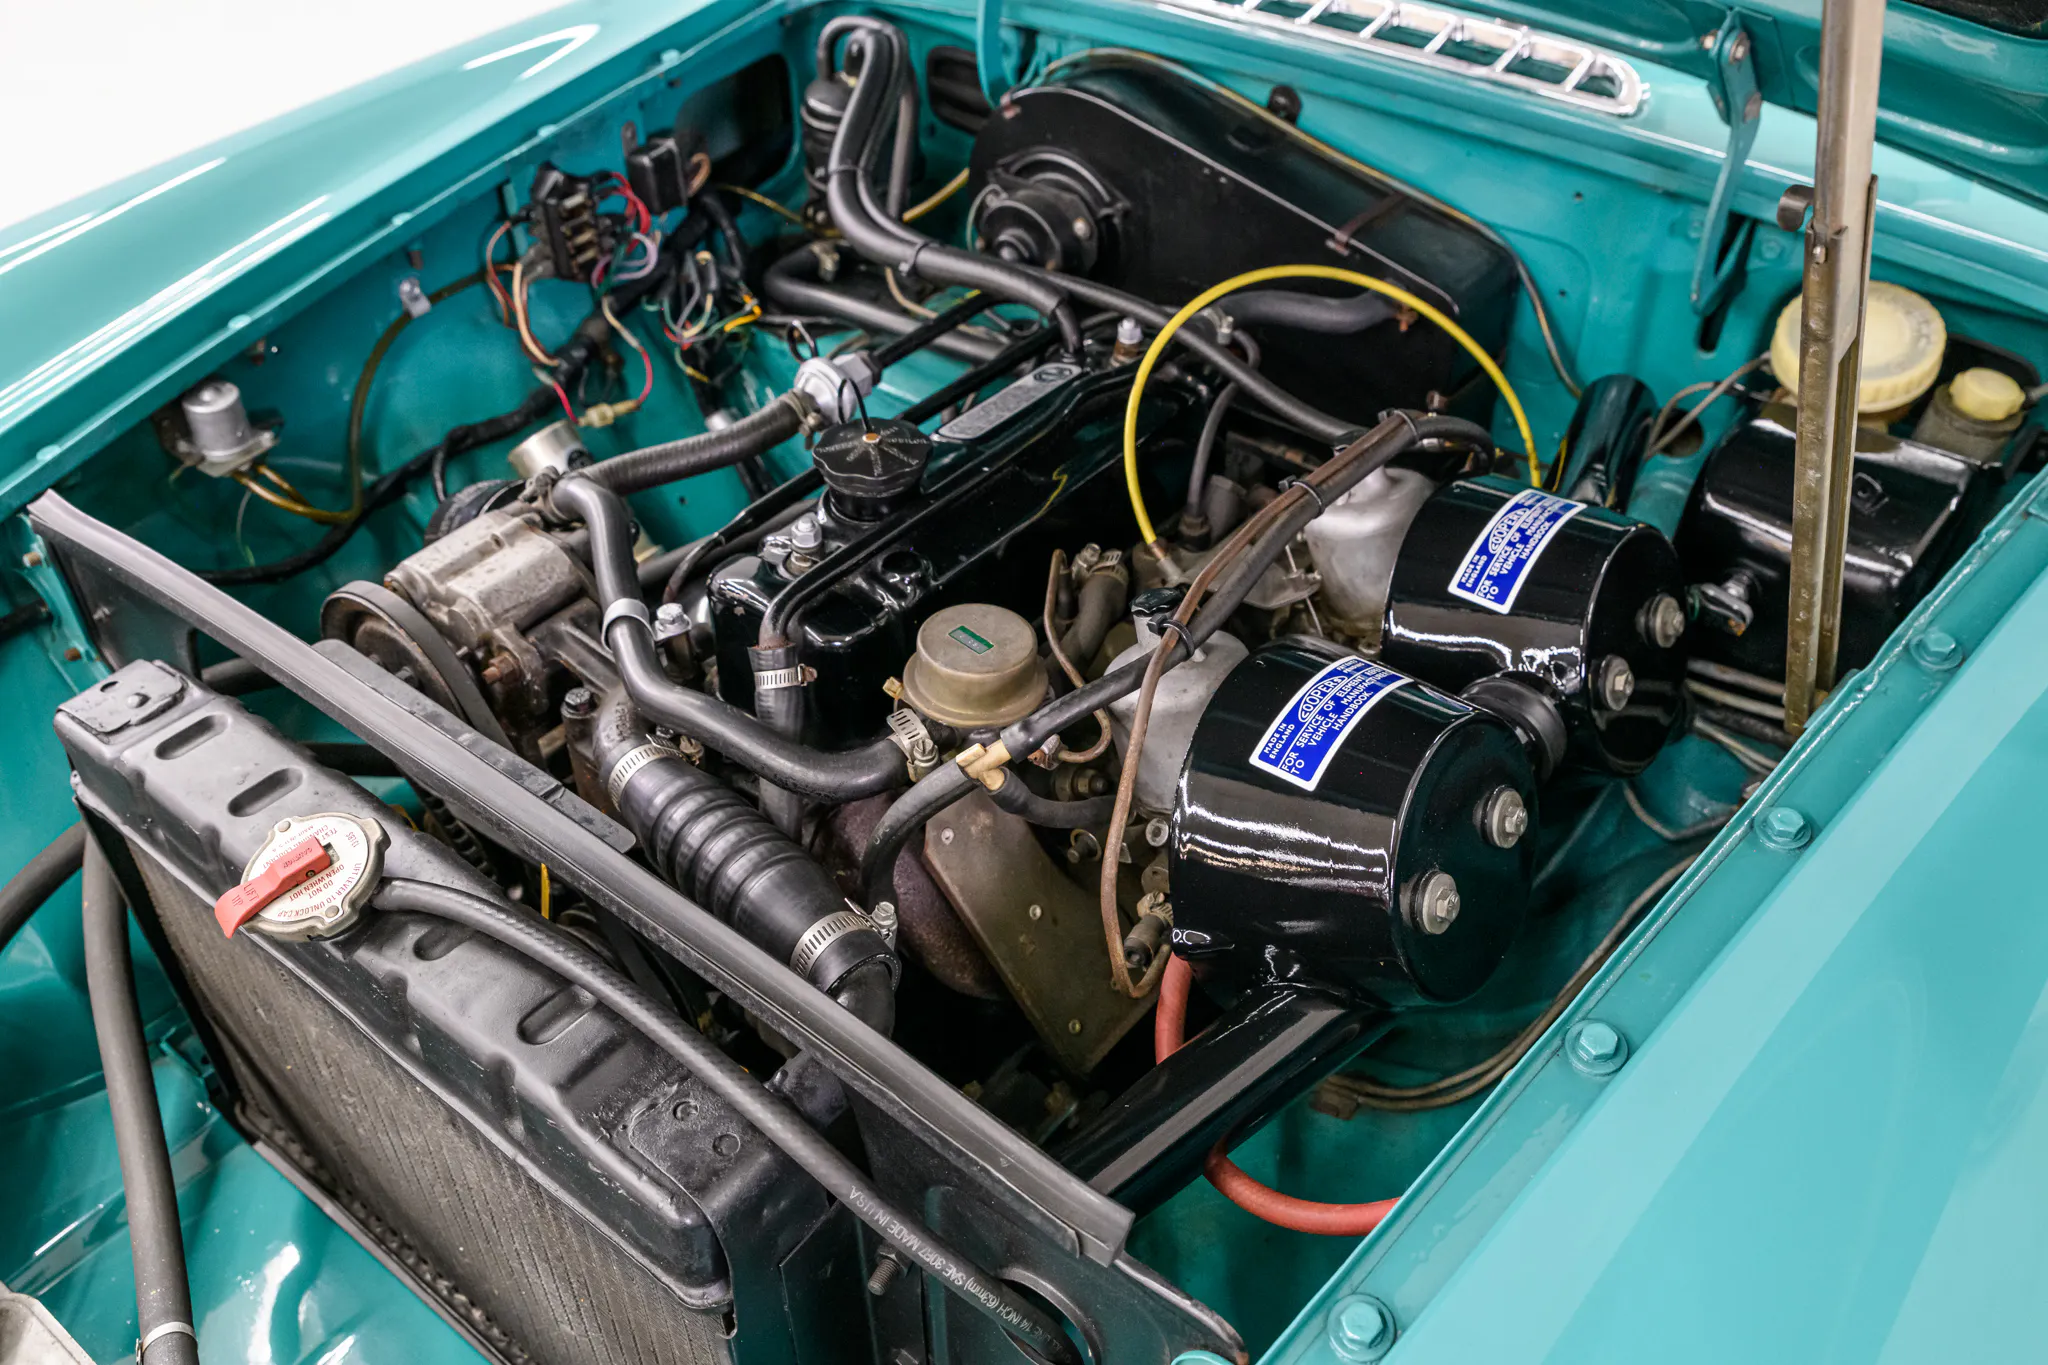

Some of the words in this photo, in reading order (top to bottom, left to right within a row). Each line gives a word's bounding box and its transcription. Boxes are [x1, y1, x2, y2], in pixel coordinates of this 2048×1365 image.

[1461, 564, 1475, 583] MADE
[1466, 555, 1488, 588] ENGLAND
[1478, 580, 1493, 598] FOR
[1489, 546, 1513, 577] SERVICE
[1510, 532, 1522, 542] OF
[1486, 586, 1499, 600] TO
[1500, 543, 1524, 575] VEHICLE
[1301, 676, 1342, 719] COOPERS
[1332, 691, 1374, 731] HANDBOOK.
[1282, 752, 1299, 772] FOR
[1296, 714, 1324, 748] SERVICE
[1324, 700, 1336, 711] OF
[1336, 675, 1365, 698] ELEMENT
[1263, 732, 1279, 754] MADE
[1278, 723, 1288, 734] IN
[1269, 724, 1296, 760] ENGLAND
[1291, 759, 1305, 775] TO
[1308, 712, 1338, 747] VEHICLE
[325, 864, 345, 879] OPEN
[351, 862, 362, 876] LIFT
[244, 883, 260, 902] LIFT
[303, 876, 326, 892] WHEN
[307, 887, 322, 900] NOT
[322, 880, 334, 890] DO
[335, 878, 354, 896] LEVER
[288, 890, 304, 902] HOT
[325, 894, 336, 903] TO
[277, 909, 294, 919] CAP
[294, 902, 325, 918] UNLOCK
[873, 1210, 890, 1227] IN
[886, 1220, 922, 1251] MADE
[942, 1264, 966, 1285] SAE
[996, 1303, 1022, 1325] INCH
